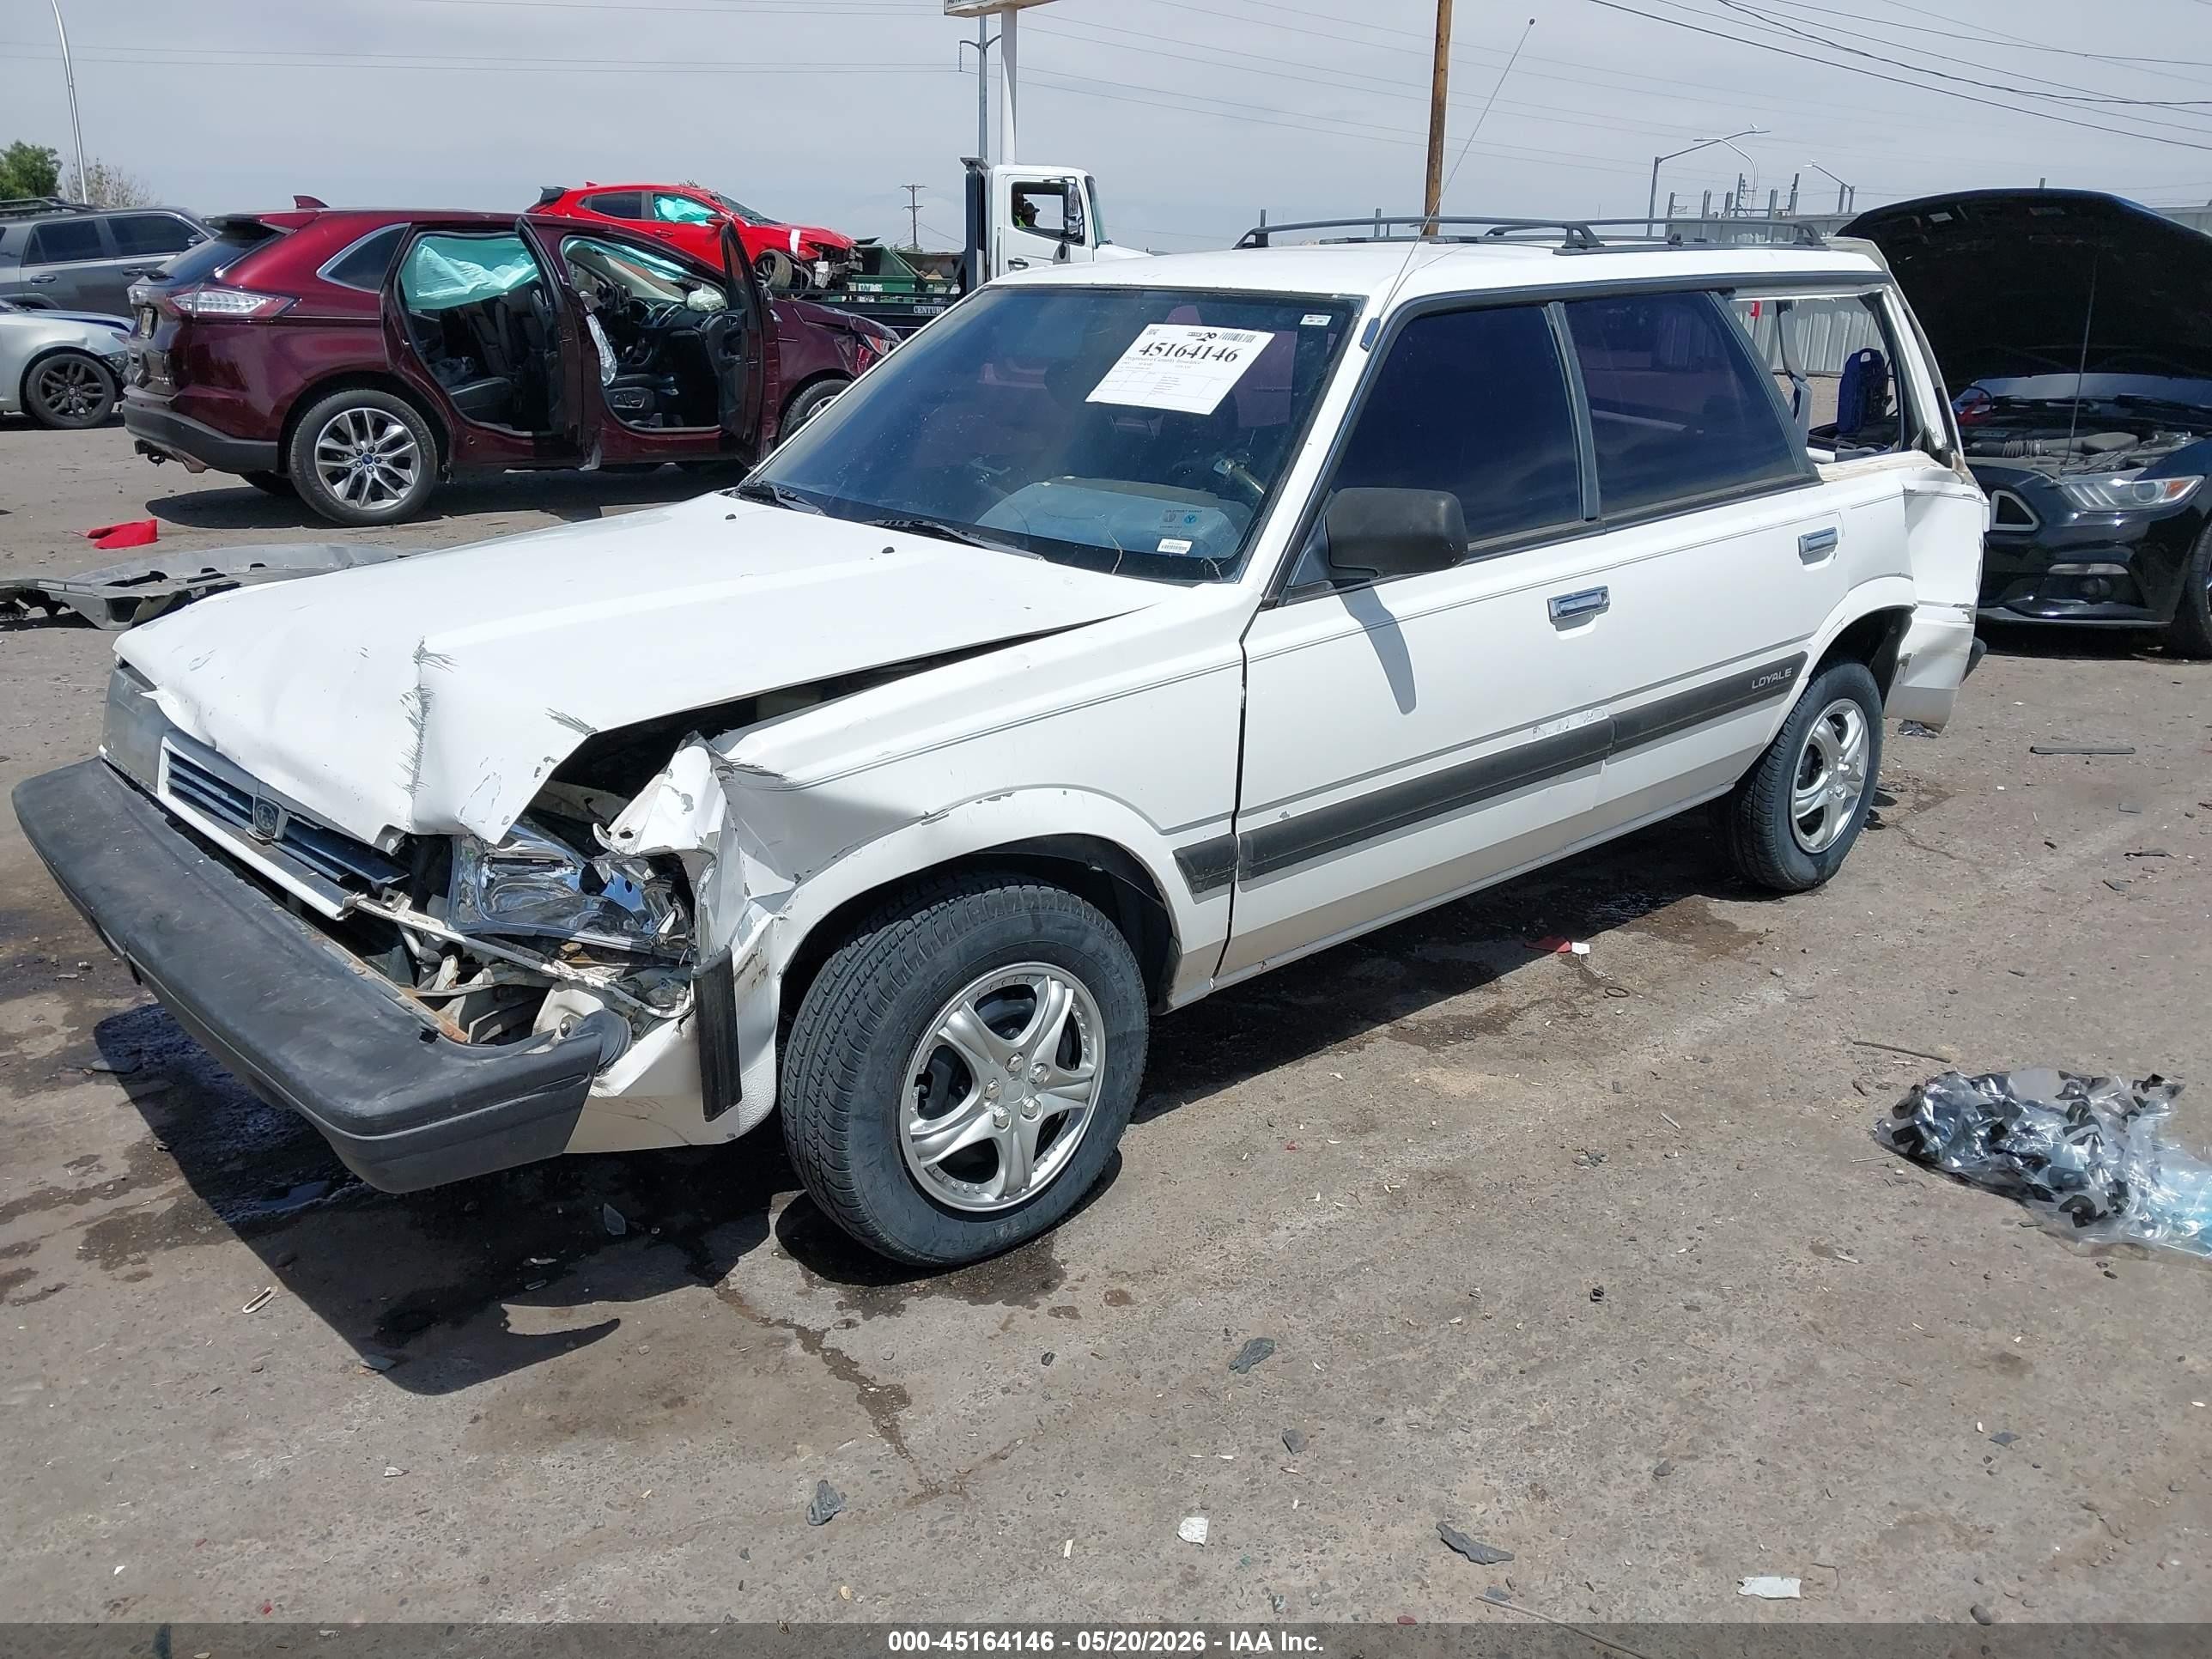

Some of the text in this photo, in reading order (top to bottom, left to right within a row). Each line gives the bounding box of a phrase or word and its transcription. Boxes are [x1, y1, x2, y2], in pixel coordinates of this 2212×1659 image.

[913, 305, 946, 314] CENTURY
[1139, 342, 1243, 363] 45164146
[1752, 667, 1792, 690] LOYALE
